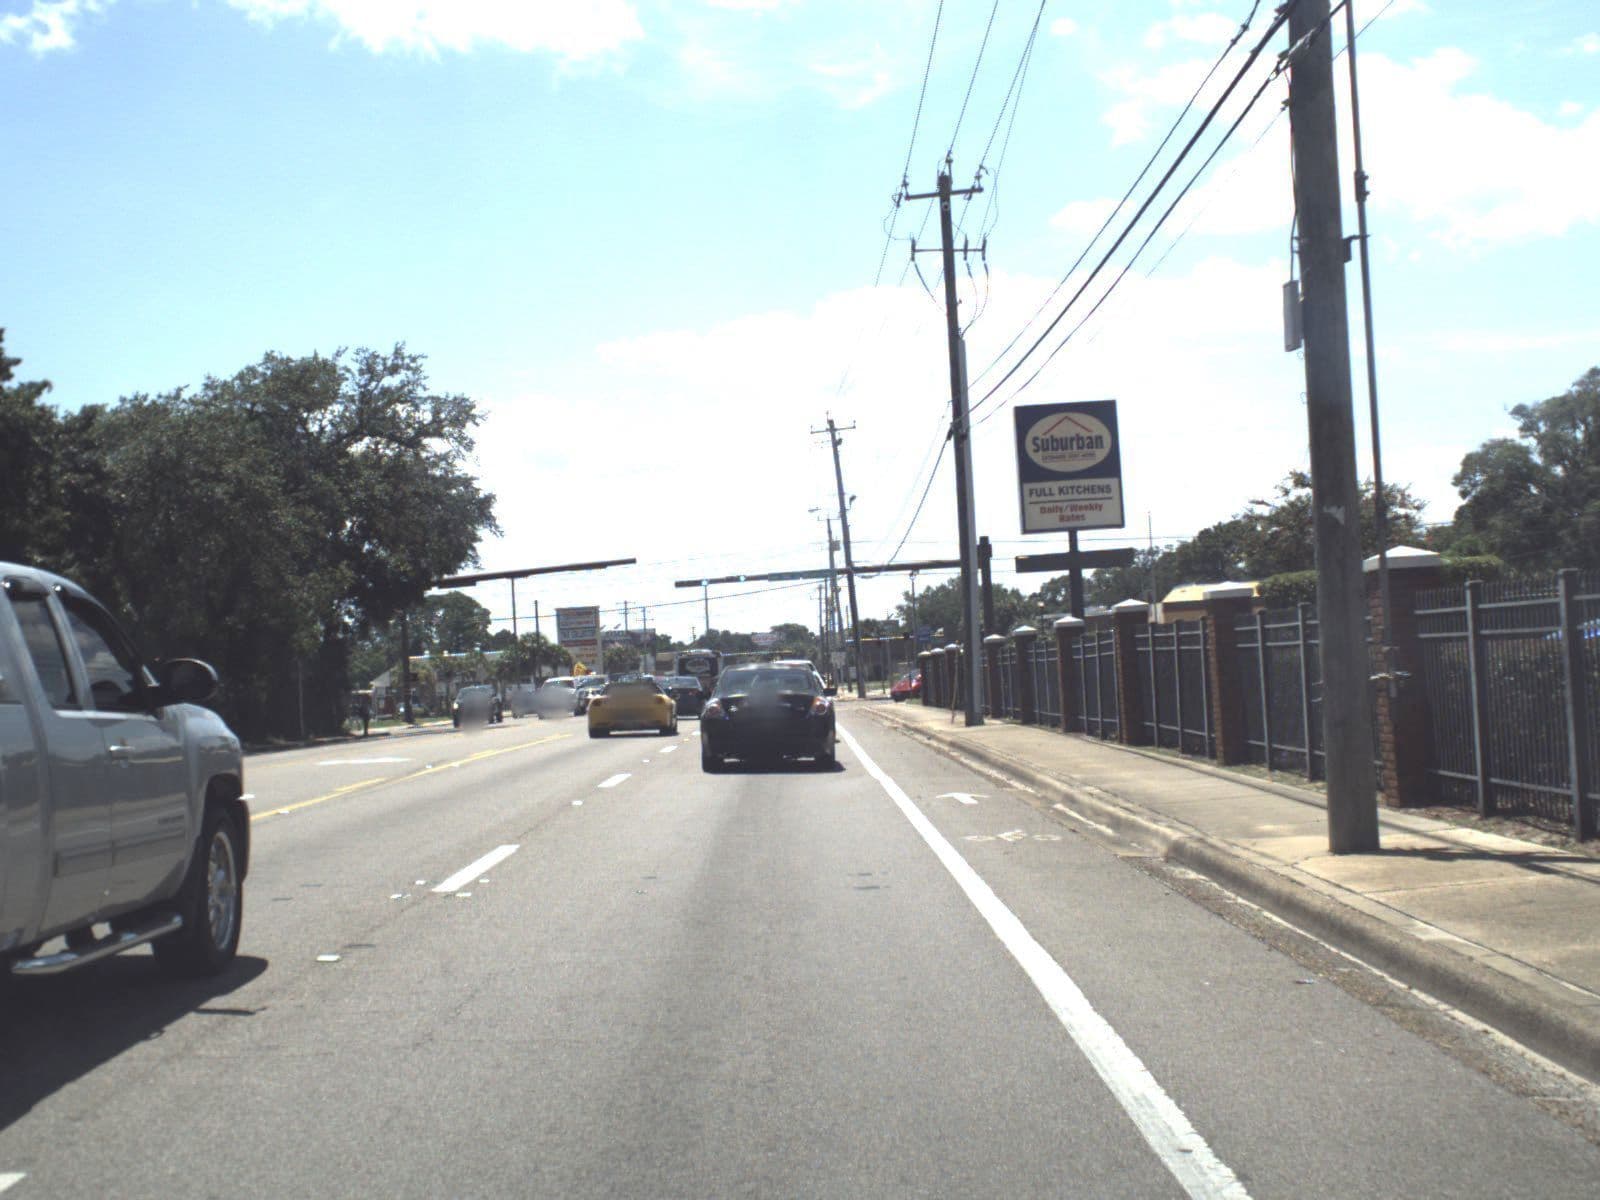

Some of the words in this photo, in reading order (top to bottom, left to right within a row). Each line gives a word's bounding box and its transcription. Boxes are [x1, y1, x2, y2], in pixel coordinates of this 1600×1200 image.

[1032, 433, 1104, 453] Suburban
[1028, 487, 1055, 498] FULL
[1058, 484, 1112, 496] KITCHENS
